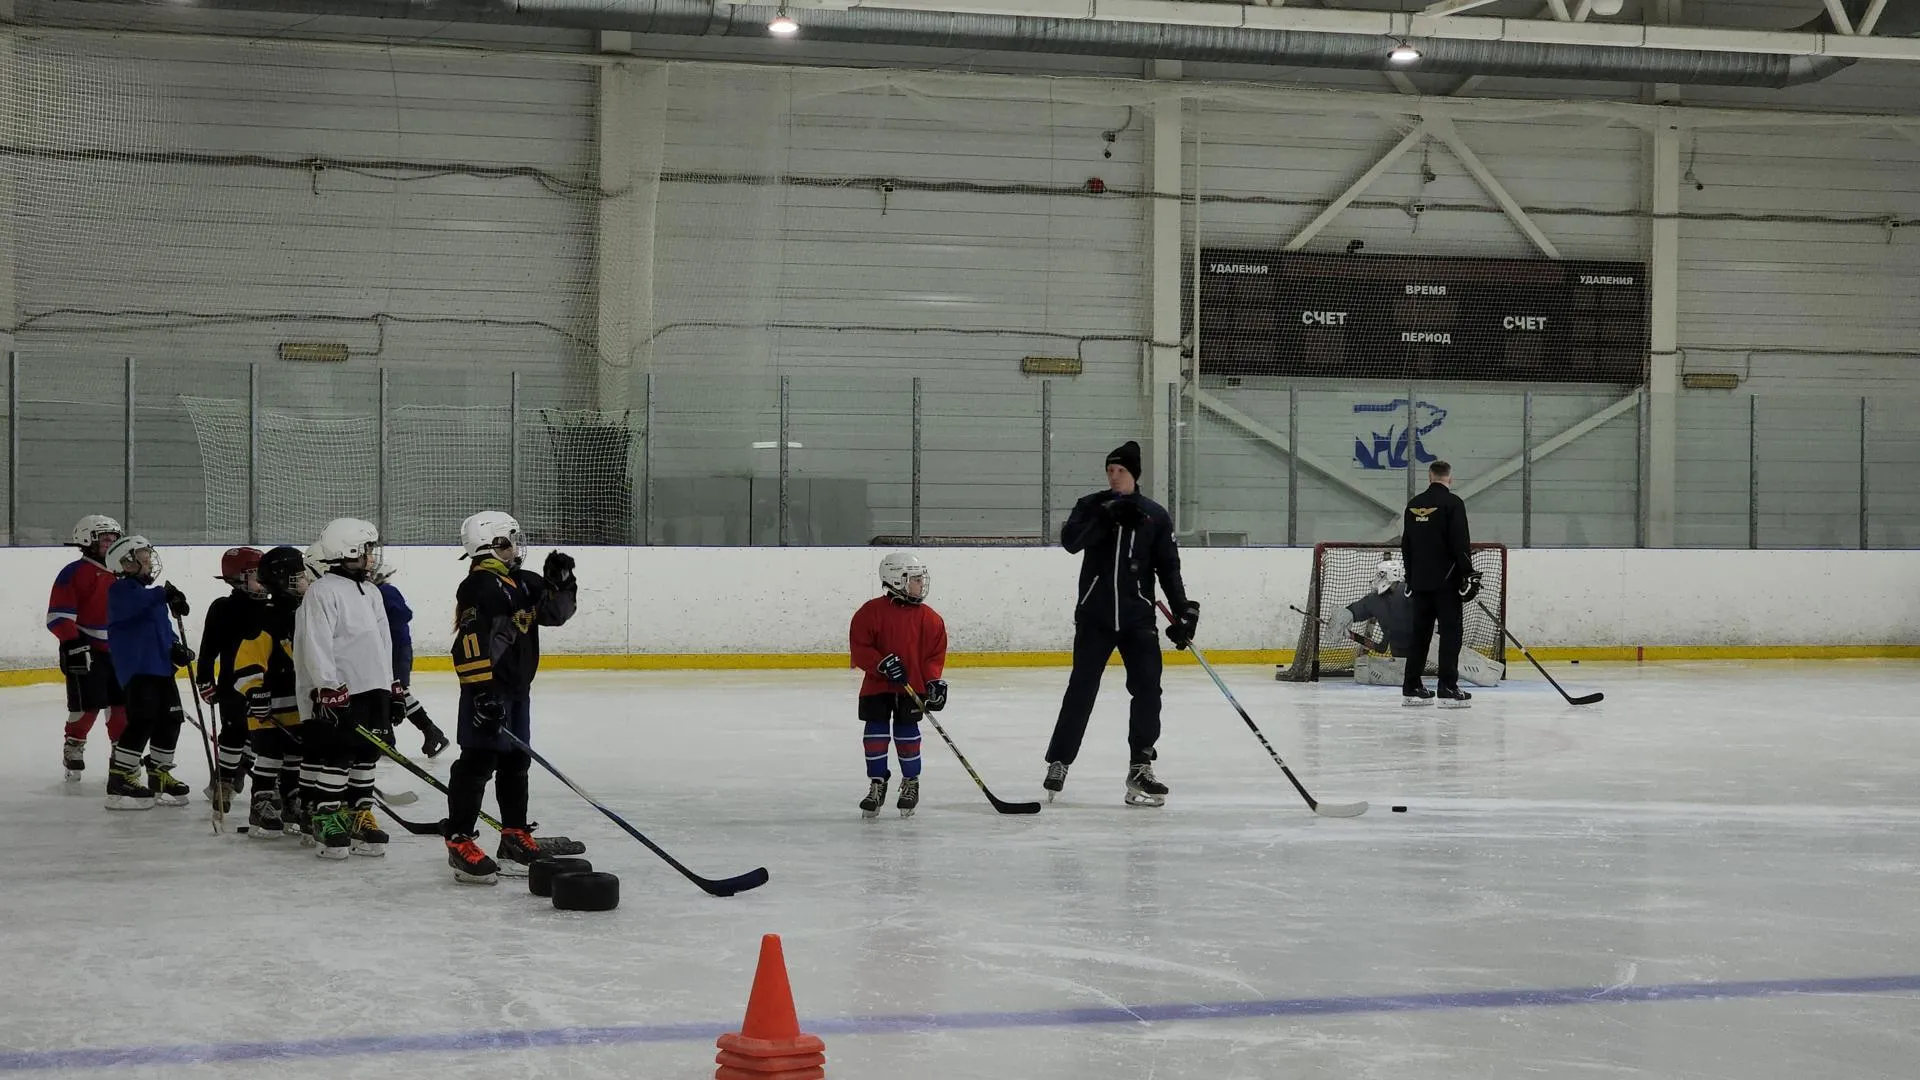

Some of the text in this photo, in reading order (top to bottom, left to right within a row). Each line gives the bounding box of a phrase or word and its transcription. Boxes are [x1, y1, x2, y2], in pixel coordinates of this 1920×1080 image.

[1210, 263, 1268, 274] УДАЛЕНИЯ
[1580, 275, 1634, 285] УДАЛЕНИЯ
[1405, 284, 1447, 296] ВРЕМЯ
[1302, 311, 1347, 325] СЧЕТ
[1503, 316, 1547, 330] СЧЕТ
[1401, 332, 1451, 345] ПЕРИОД
[462, 633, 480, 659] 11
